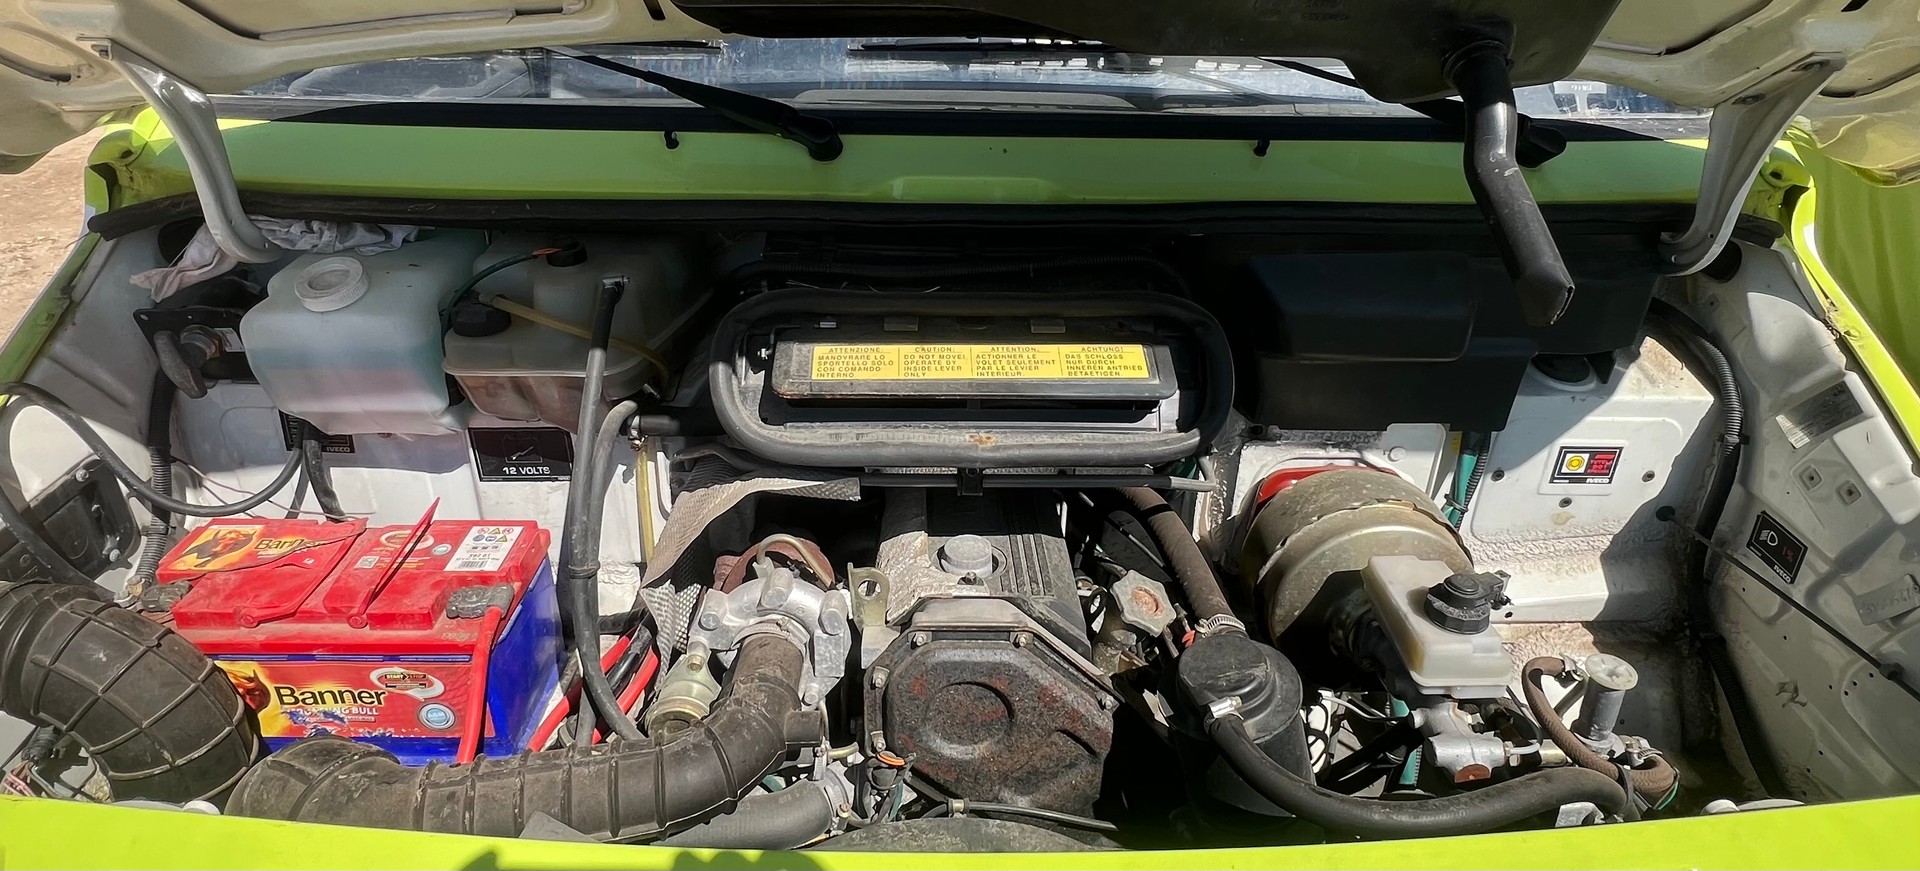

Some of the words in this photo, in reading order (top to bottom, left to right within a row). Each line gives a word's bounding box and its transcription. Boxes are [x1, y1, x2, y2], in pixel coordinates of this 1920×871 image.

[502, 467, 518, 475] 12
[519, 466, 551, 475] VOLTS
[1773, 564, 1792, 583] IVECO
[274, 685, 387, 706] Banner
[352, 707, 379, 715] BULL
